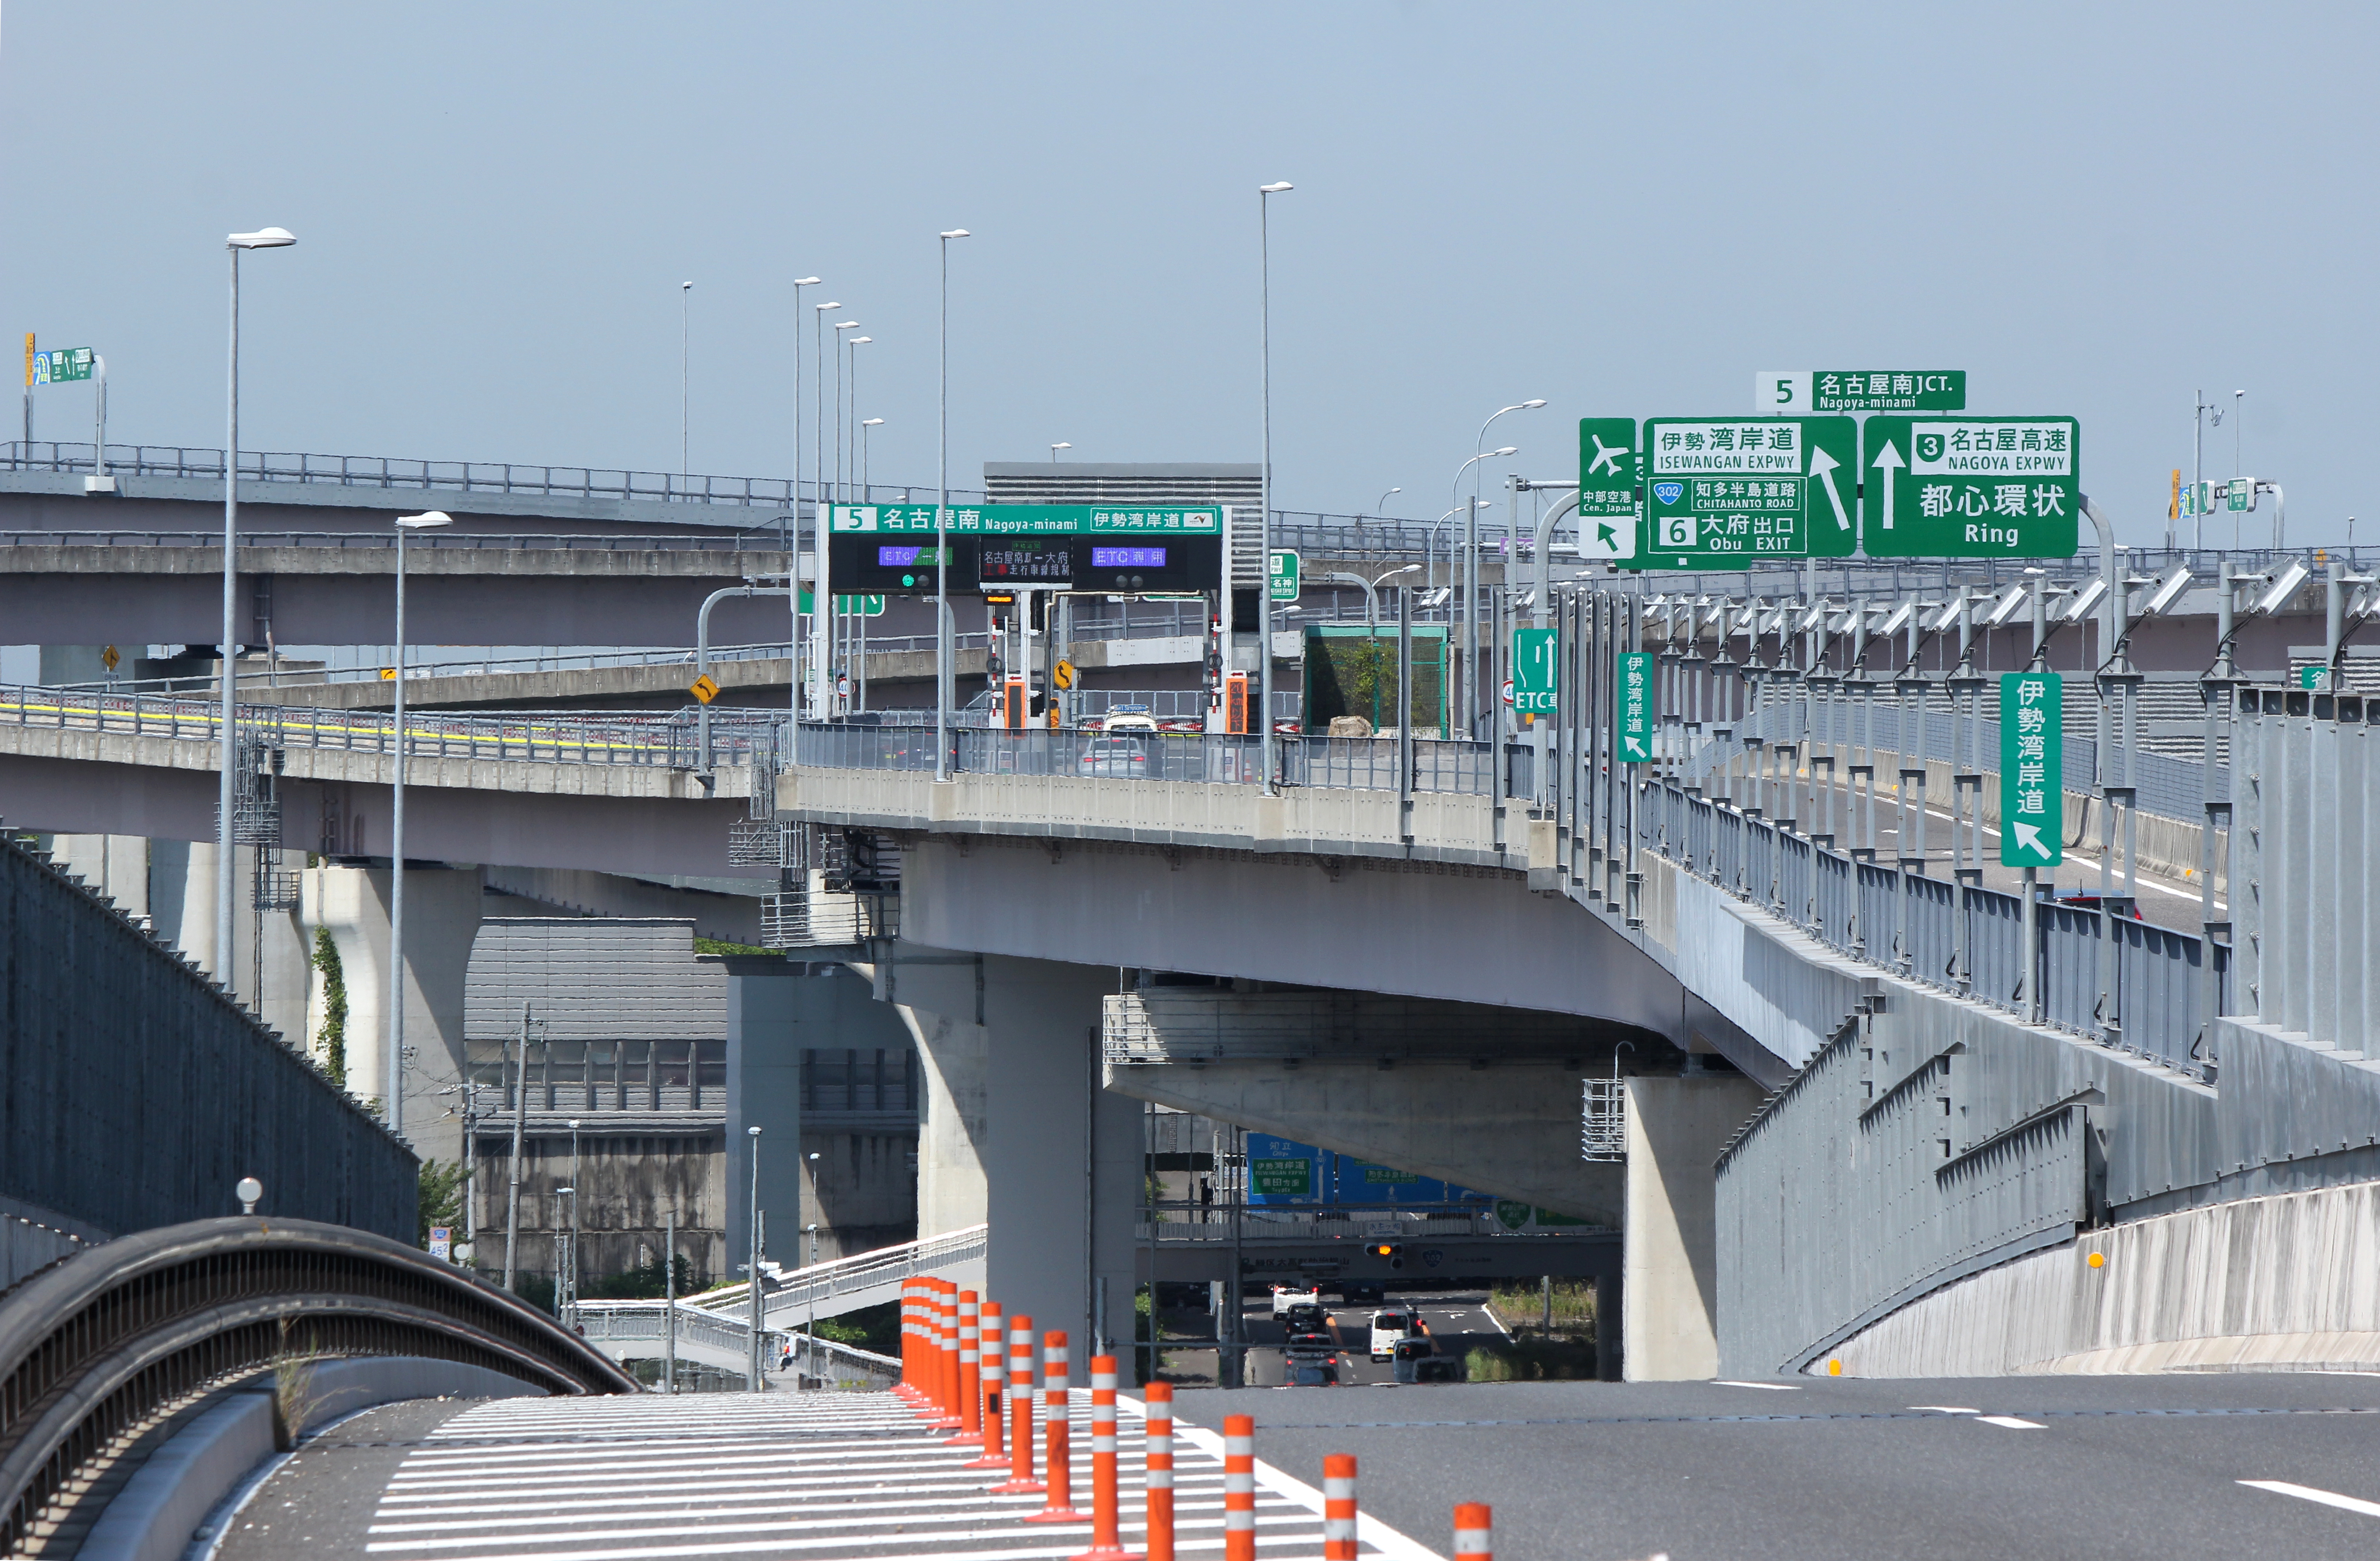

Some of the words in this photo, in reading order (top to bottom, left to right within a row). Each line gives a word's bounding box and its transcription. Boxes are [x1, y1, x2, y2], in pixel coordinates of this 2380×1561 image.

[1776, 379, 1793, 404] 5
[1820, 373, 1953, 395] 名古屋南JCT.
[1820, 396, 1916, 410] Nagoya-minami
[1661, 427, 1794, 451] 伊勢湾岸道
[1923, 437, 1938, 456] 3
[1950, 428, 2067, 451] 名古屋高速
[1660, 455, 1741, 469] ISEWANGAN
[1748, 456, 1794, 469] EXPWY
[1948, 456, 2009, 470] NAGOYA
[2016, 456, 2065, 470] EXPWY
[1583, 490, 1631, 503] 中部空港
[1658, 486, 1679, 497] 302
[1696, 482, 1796, 497] 知多半島道路
[1606, 504, 1631, 513] Japan
[1697, 499, 1762, 509] CHITAHANTO
[1766, 499, 1794, 508] ROAD
[1919, 483, 2066, 517] 都心環状
[849, 509, 863, 528] 5
[883, 508, 980, 530] 名古屋南
[985, 518, 1077, 532] Nagoya-minami
[1094, 512, 1180, 527] 伊勢湾岸道
[1701, 513, 1794, 535] 大府出口
[1670, 519, 1686, 543] 6
[1965, 523, 2018, 547] Ring
[1710, 538, 1741, 550] Obu
[1756, 537, 1790, 550] EXIT
[1271, 579, 1292, 588] 名神
[1626, 656, 1644, 733] 伊勢湾岸道
[2017, 679, 2046, 814] 伊勢湾岸道
[1257, 1161, 1305, 1169] 伊勢湾岸道
